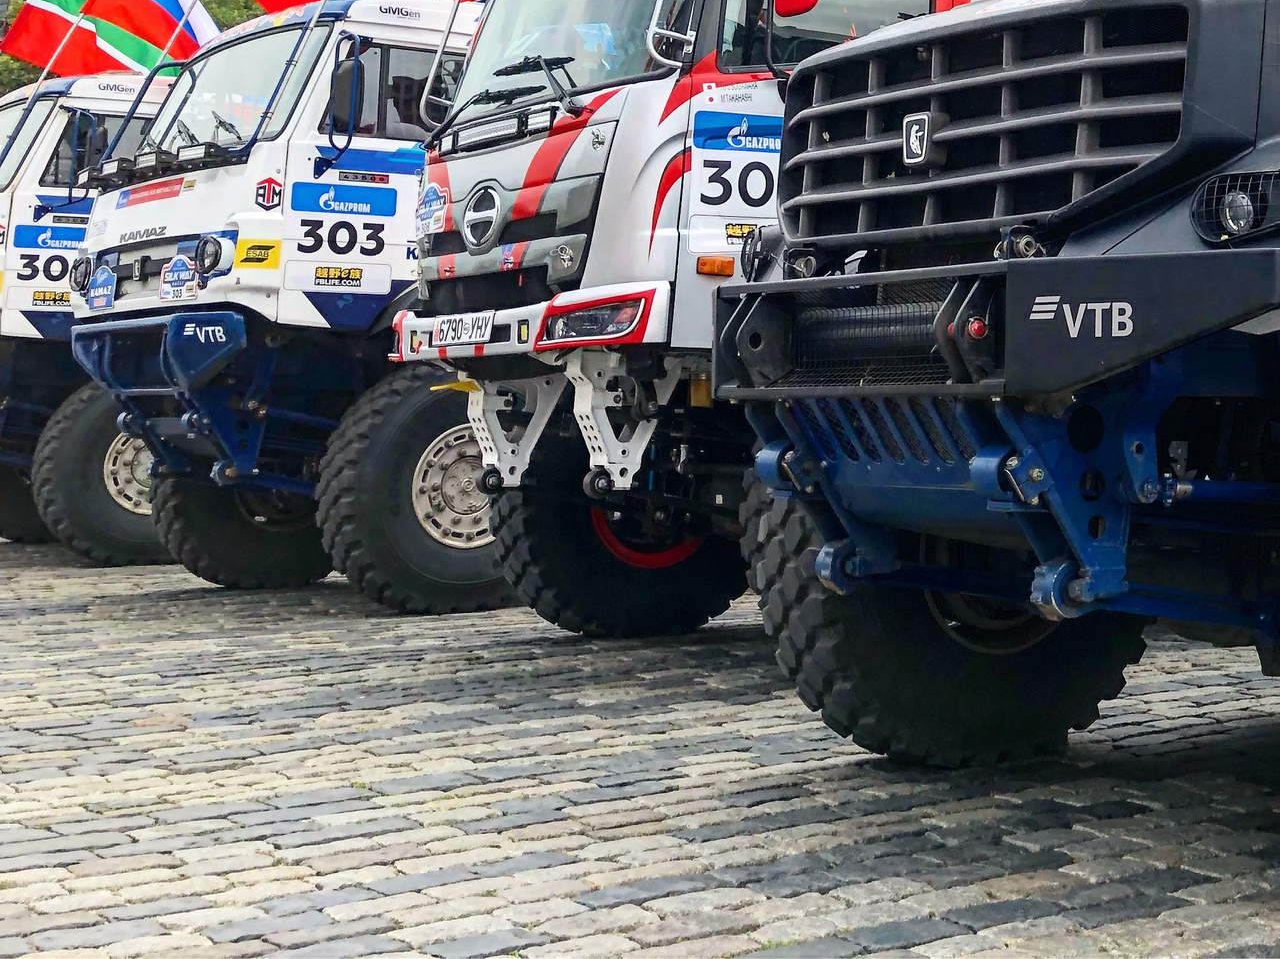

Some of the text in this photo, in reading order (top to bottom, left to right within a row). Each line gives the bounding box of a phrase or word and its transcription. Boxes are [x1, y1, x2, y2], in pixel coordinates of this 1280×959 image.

[745, 137, 781, 150] GAZPRO
[700, 159, 775, 208] 30
[334, 201, 371, 213] GAZPROM
[120, 226, 167, 244] KAMAZ
[297, 219, 386, 257] 303
[245, 250, 270, 259] ESAB
[17, 254, 70, 282] 30
[315, 278, 361, 287] FBLIFE.COM
[90, 285, 112, 298] KAMAZ
[1061, 301, 1134, 338] VTB
[196, 326, 227, 343] VTB
